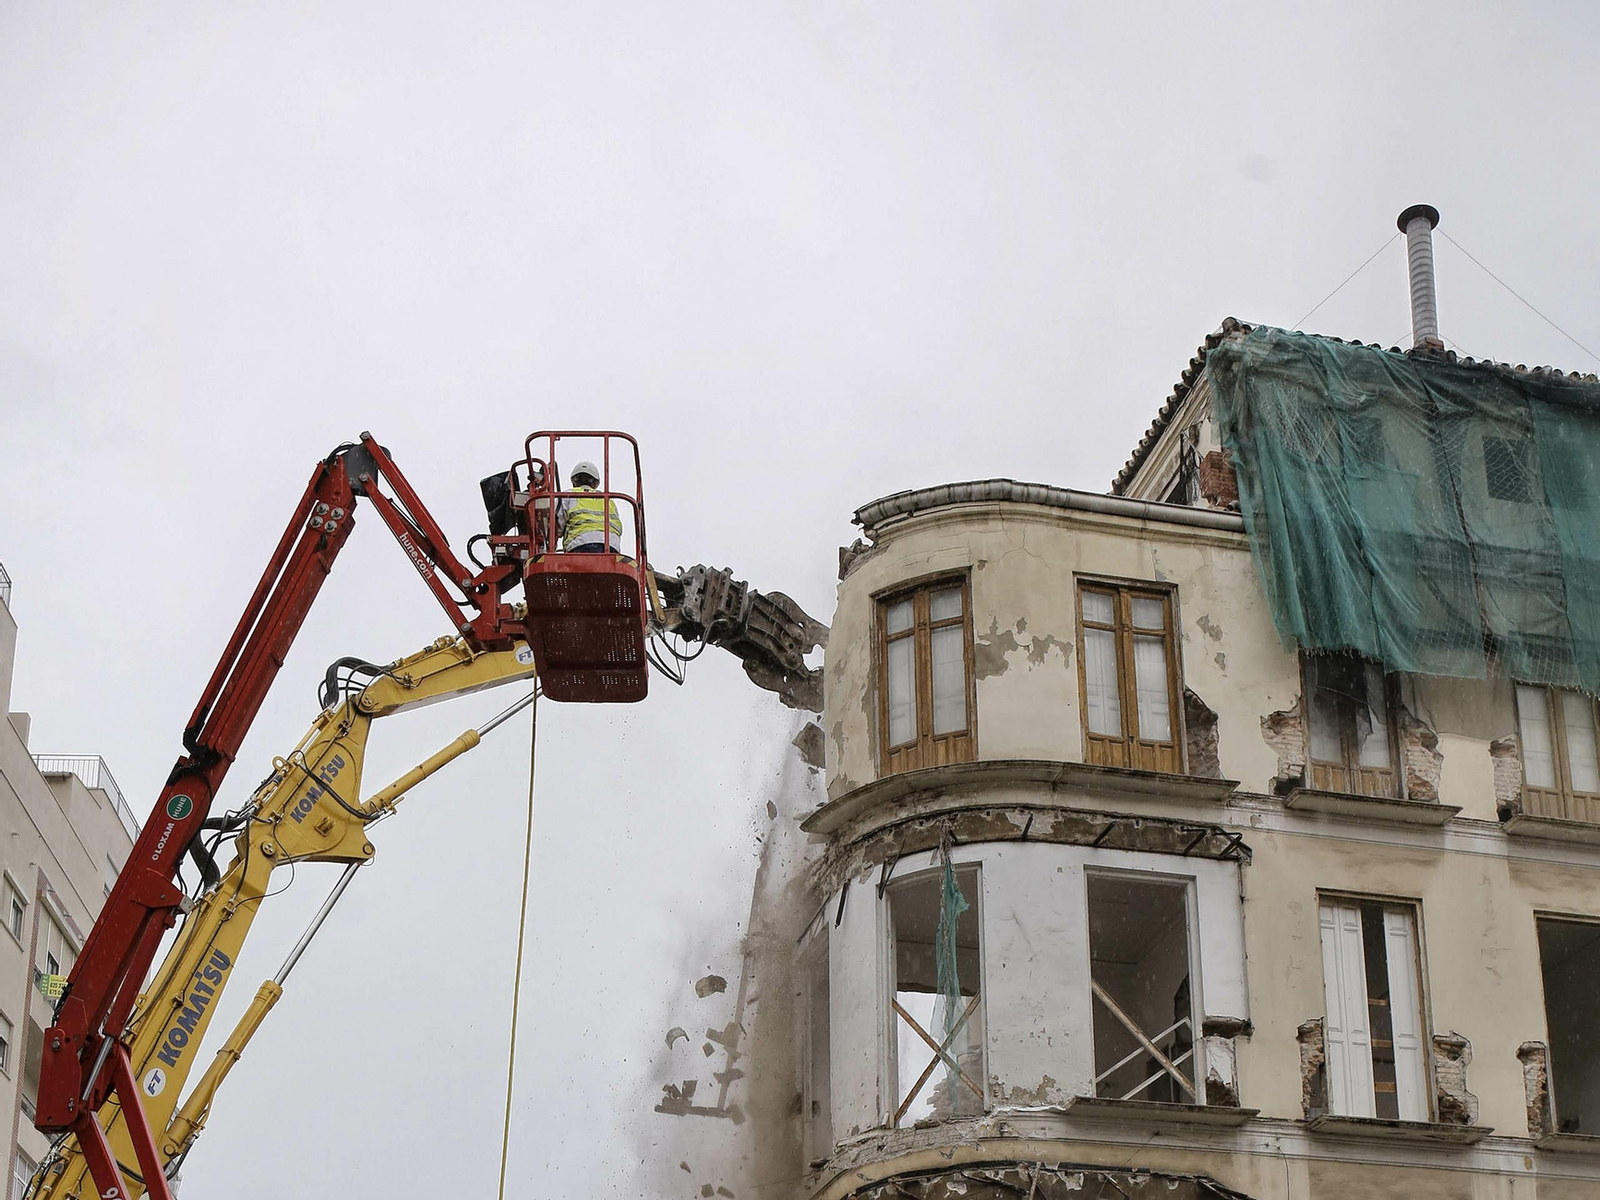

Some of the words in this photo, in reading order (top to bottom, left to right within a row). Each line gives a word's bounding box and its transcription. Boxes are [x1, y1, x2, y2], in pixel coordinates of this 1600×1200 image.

[400, 531, 433, 579] hune.com
[172, 796, 187, 818] HUNE
[157, 949, 231, 1068] KOMATSU
[147, 1070, 162, 1095] FT
